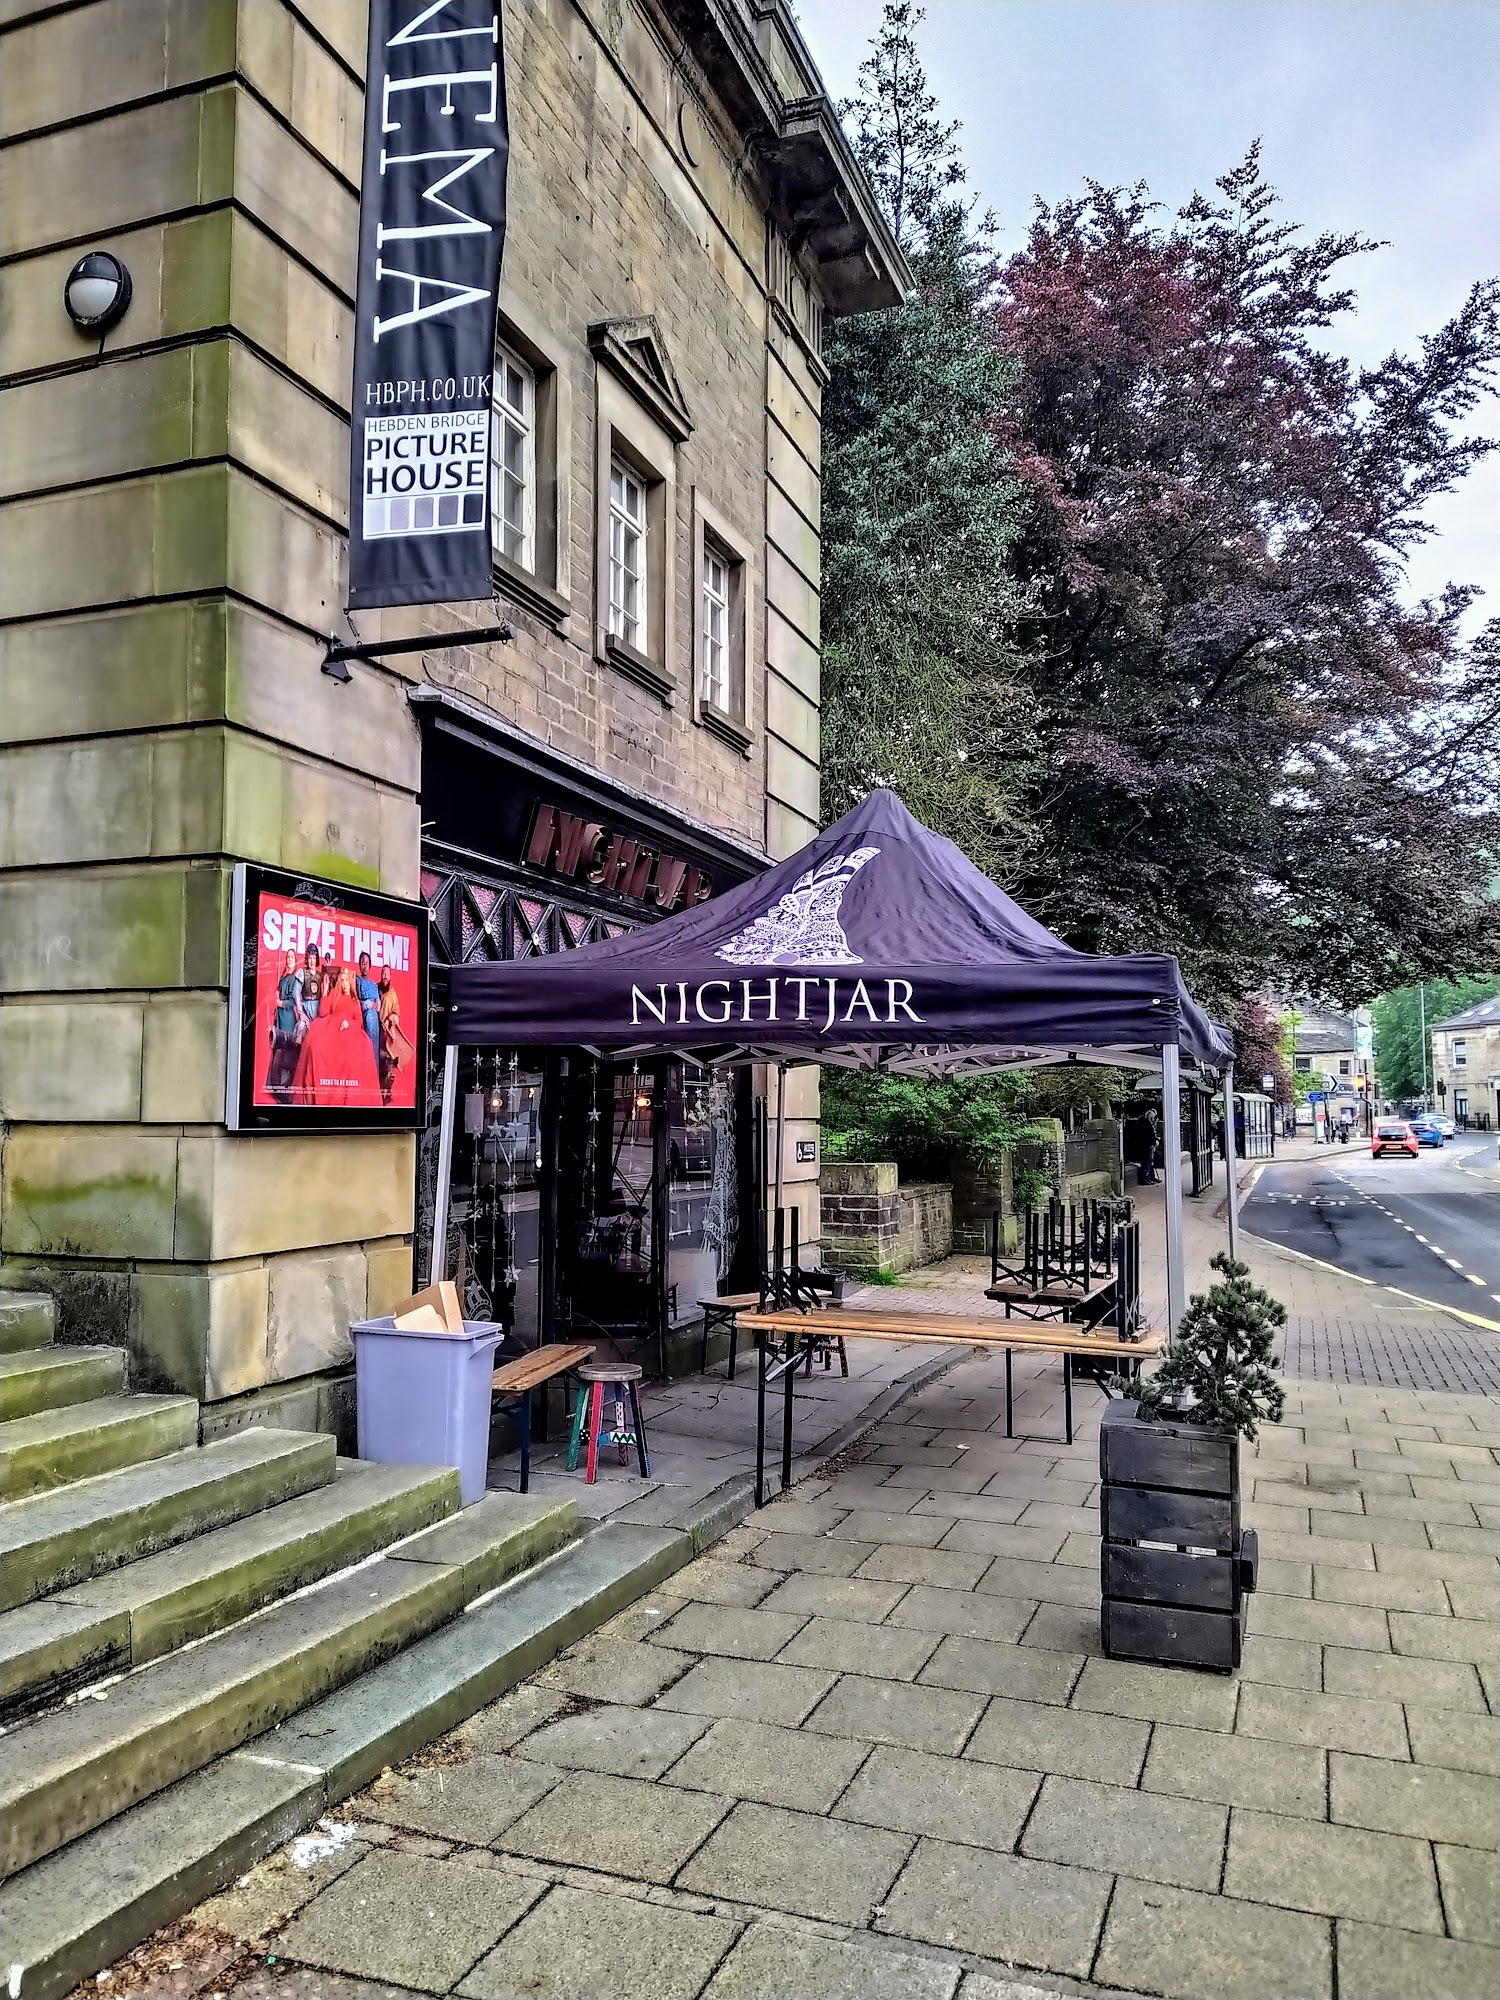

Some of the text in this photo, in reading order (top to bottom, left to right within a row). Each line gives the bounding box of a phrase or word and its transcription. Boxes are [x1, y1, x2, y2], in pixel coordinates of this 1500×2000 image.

[365, 375, 491, 405] HBPH.CO.UK
[368, 413, 485, 432] HEBDEN BRIDGE
[367, 431, 485, 461] PICTURE
[366, 460, 484, 494] HOUSE
[263, 908, 410, 971] SEIZE THEM!
[629, 977, 927, 1034] NIGHTJAR
